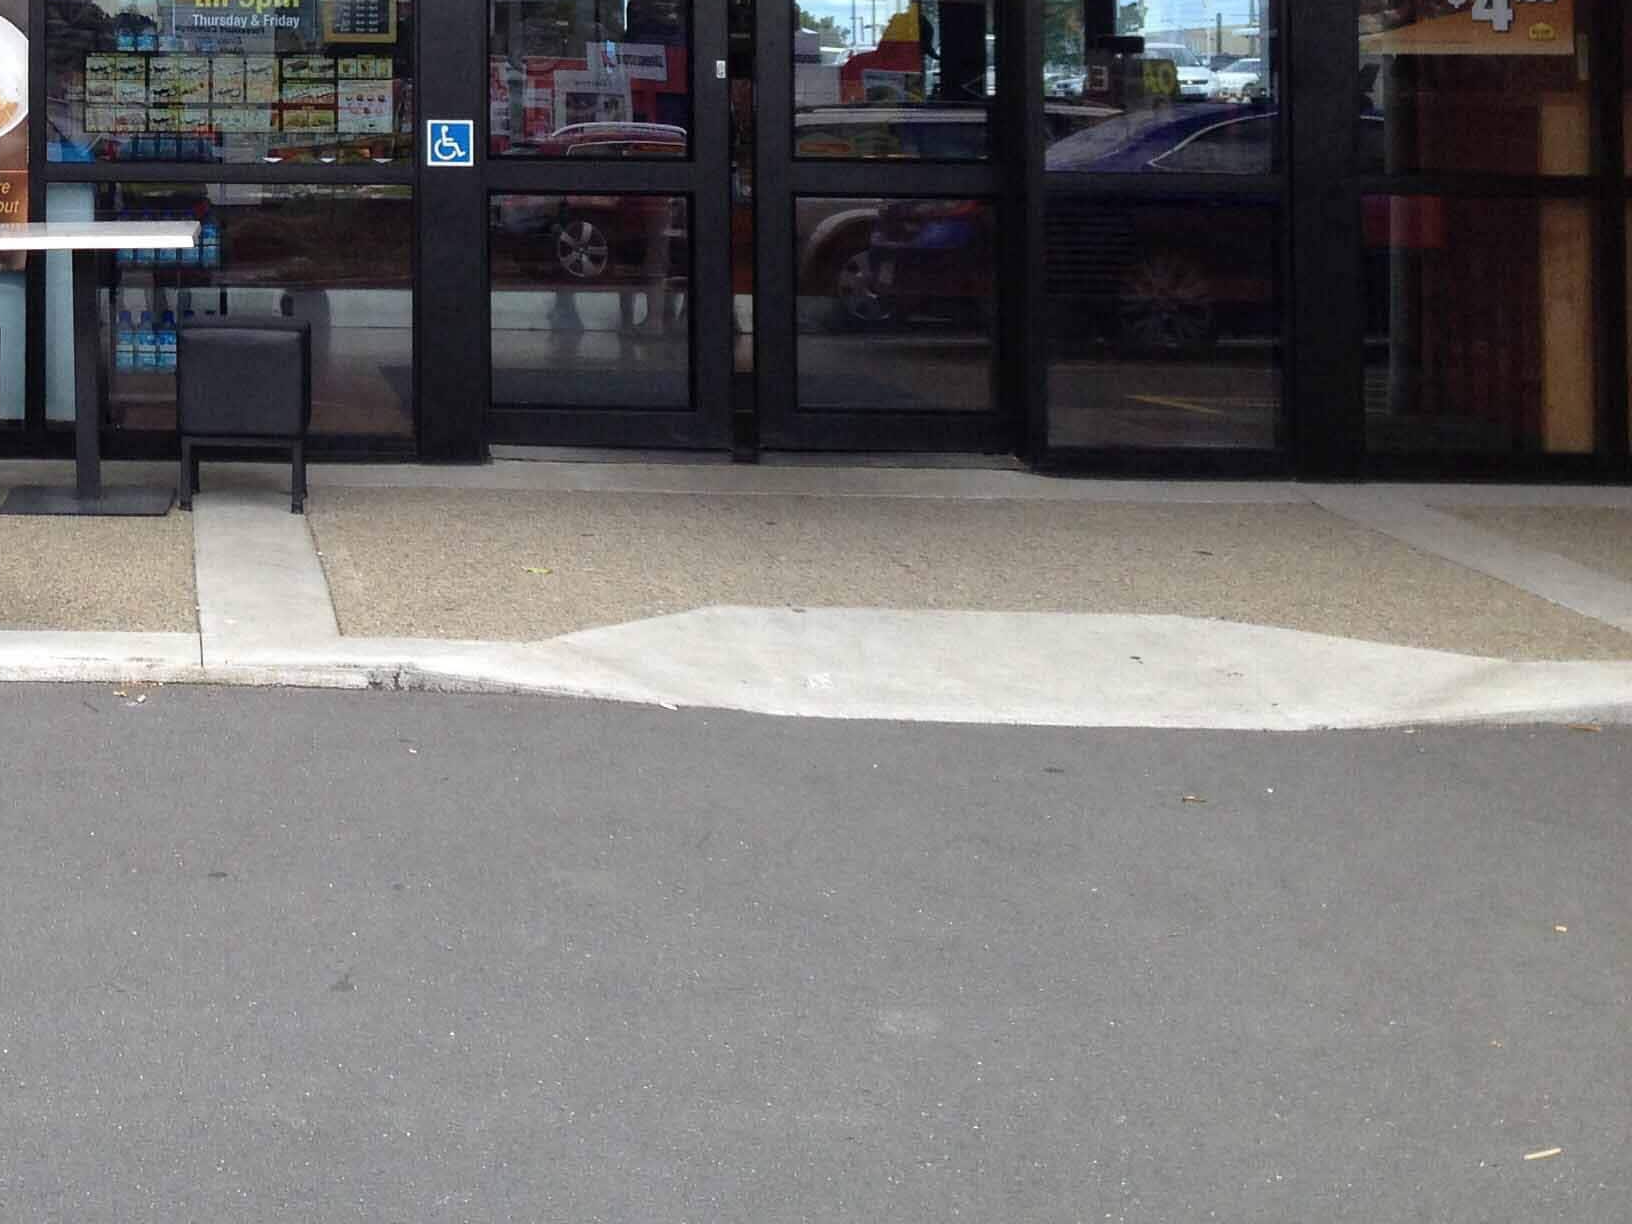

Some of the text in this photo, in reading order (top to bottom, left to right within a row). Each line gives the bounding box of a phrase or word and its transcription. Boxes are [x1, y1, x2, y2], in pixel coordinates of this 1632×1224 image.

[192, 14, 300, 28] Thursday & Friday
